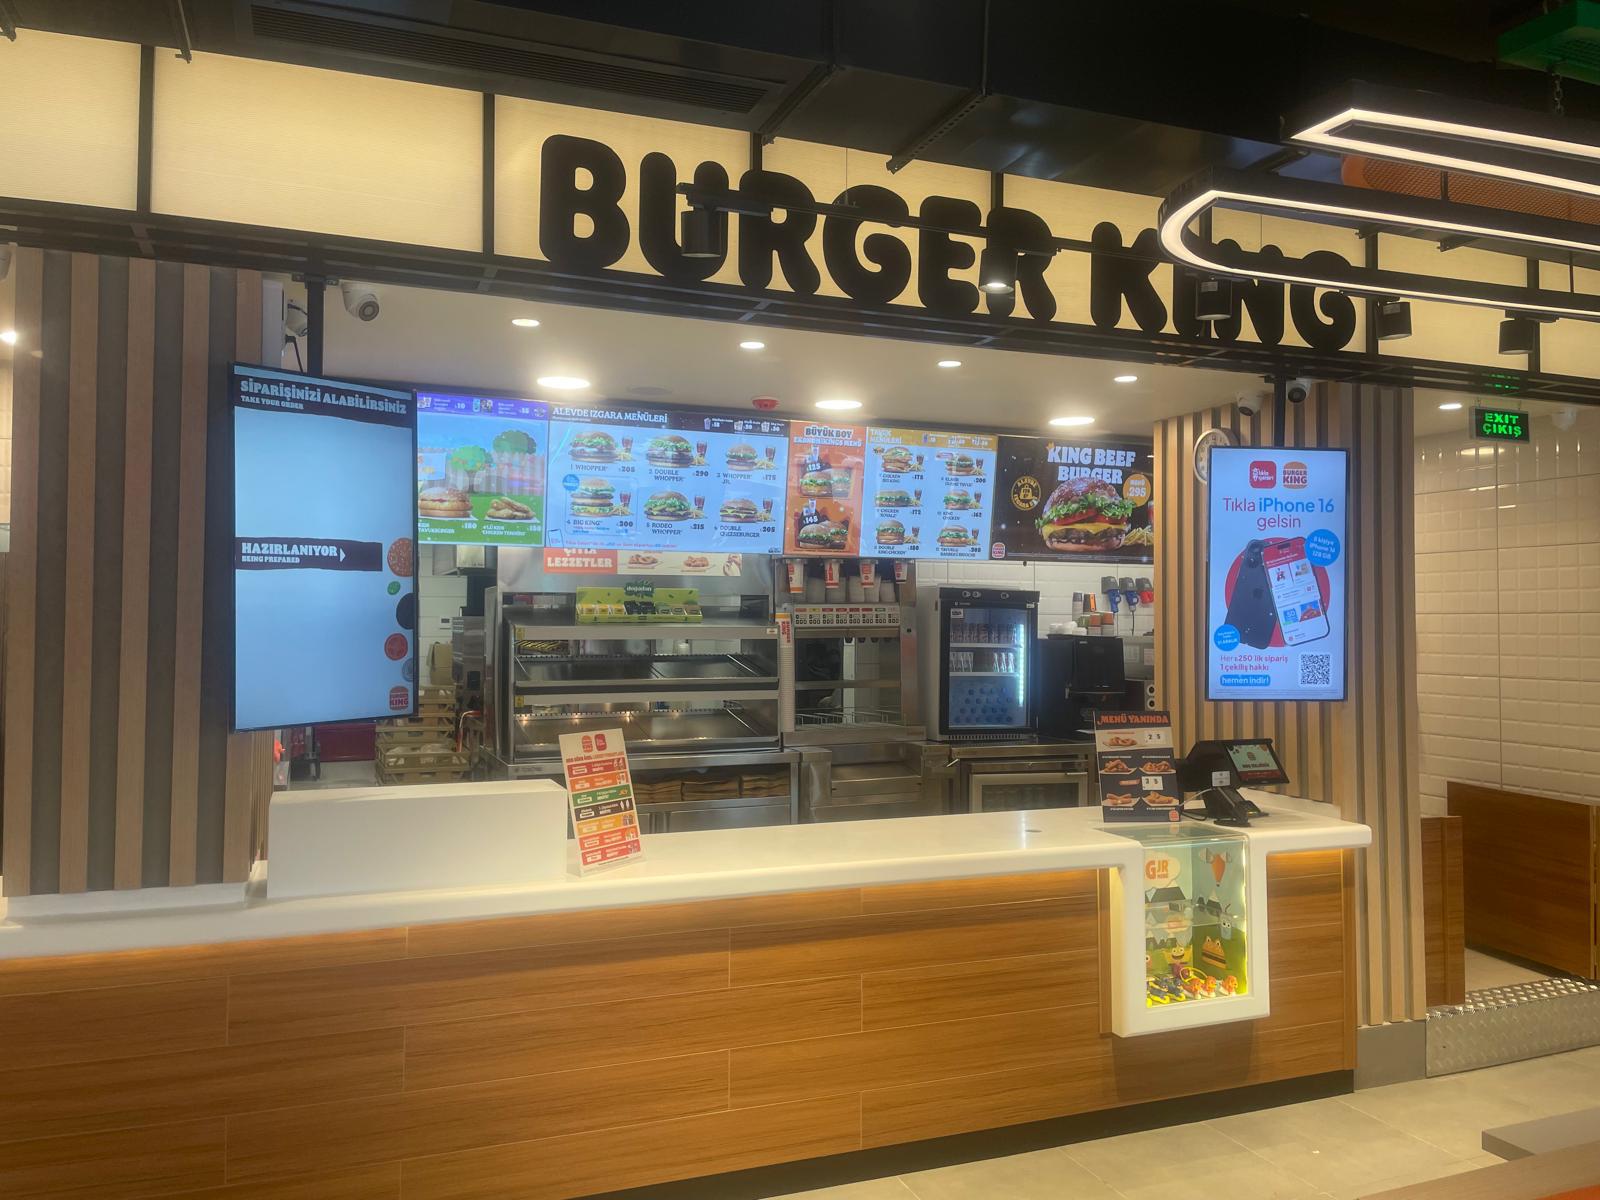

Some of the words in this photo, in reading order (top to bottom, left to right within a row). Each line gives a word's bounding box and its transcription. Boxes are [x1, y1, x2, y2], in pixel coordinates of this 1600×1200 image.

[539, 134, 1057, 319] BURGER
[240, 378, 321, 402] SİPARİŞİNİZİ
[323, 392, 407, 414] ALABİLİRSİNİZ
[240, 395, 260, 404] TAKE
[261, 398, 280, 407] YOUR
[281, 400, 304, 410] ORDER
[552, 407, 588, 417] ALEVDE
[624, 411, 668, 423] MENÜLERİ
[1484, 412, 1519, 424] EXIT
[805, 426, 834, 437] BÜYÜK
[835, 430, 852, 439] BOY
[1482, 423, 1522, 438] ÇIKIŞ
[1047, 445, 1093, 465] KING
[1094, 447, 1137, 467] BEEF
[1058, 465, 1123, 485] BURGER
[1282, 475, 1308, 484] KING
[1223, 497, 1256, 512] Tıkla
[1259, 497, 1315, 513] iPhone
[1318, 498, 1335, 513] 16
[1256, 513, 1302, 531] gelsin
[241, 542, 338, 557] HAZIRLANIYOR
[241, 555, 264, 563] BEING
[264, 556, 300, 564] PREPARED
[547, 557, 613, 568] LEZZETLER
[1222, 676, 1249, 685] hemen
[1097, 712, 1127, 725] MENÜ
[1128, 714, 1169, 724] YANINDA
